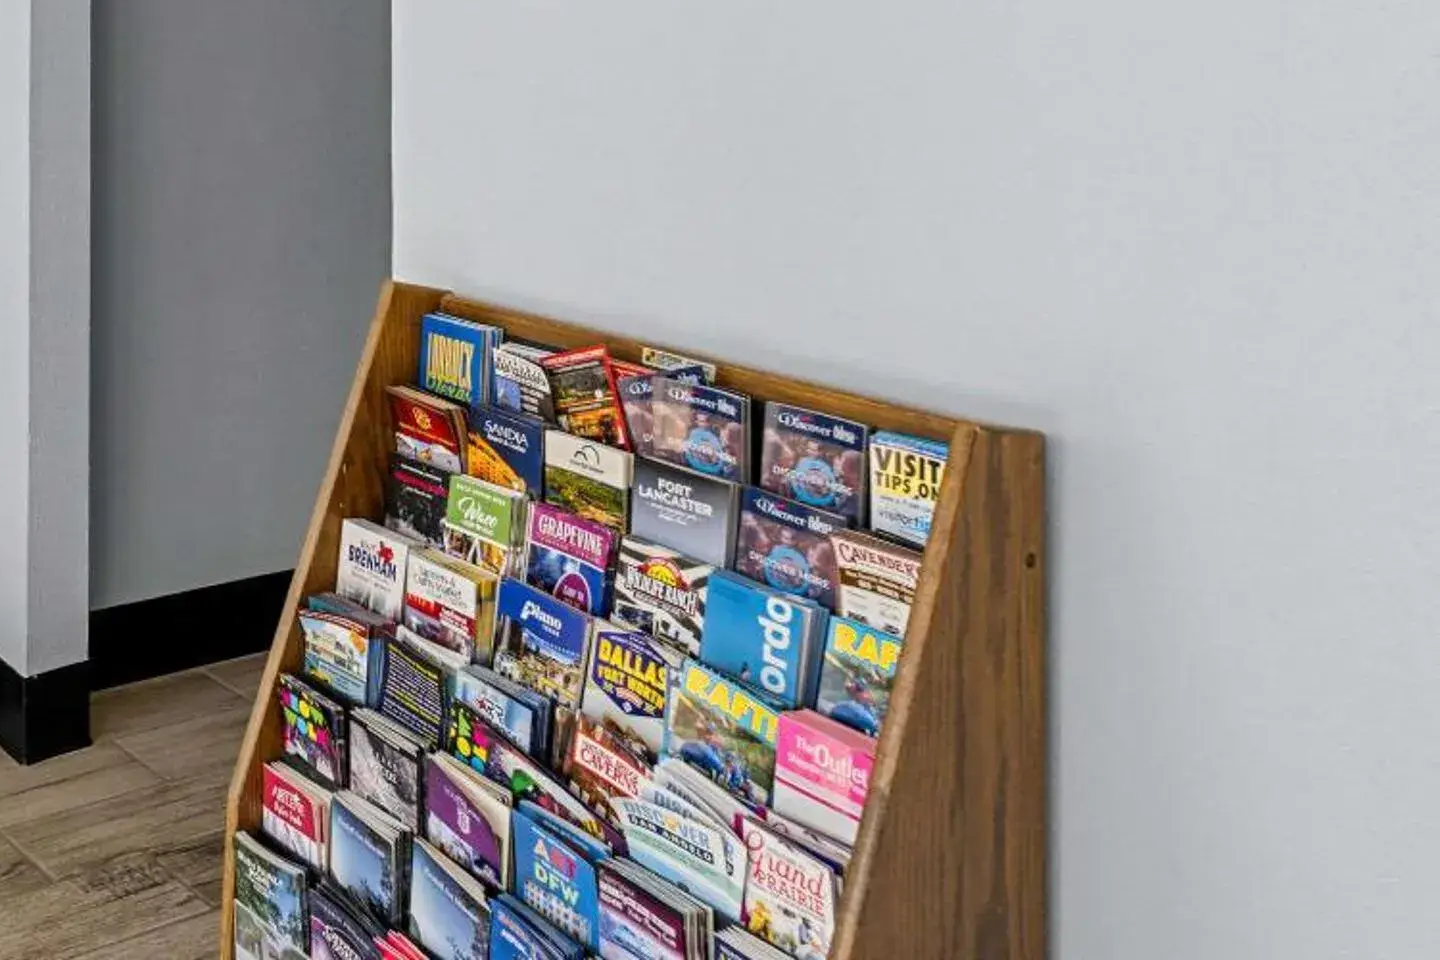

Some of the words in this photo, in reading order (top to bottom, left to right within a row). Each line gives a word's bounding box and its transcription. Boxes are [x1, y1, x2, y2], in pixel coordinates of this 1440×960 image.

[483, 419, 529, 448] SANDIA
[873, 447, 940, 484] VISIT
[875, 470, 910, 494] TIPS
[638, 484, 714, 517] LANCASTER
[658, 477, 693, 496] FORT
[539, 513, 604, 557] GRAPEVINE
[348, 544, 397, 582] BRENHAM
[519, 599, 563, 631] Plano
[598, 637, 667, 691] DALLAS
[534, 860, 580, 906] DFW
[746, 830, 824, 899] Grand
